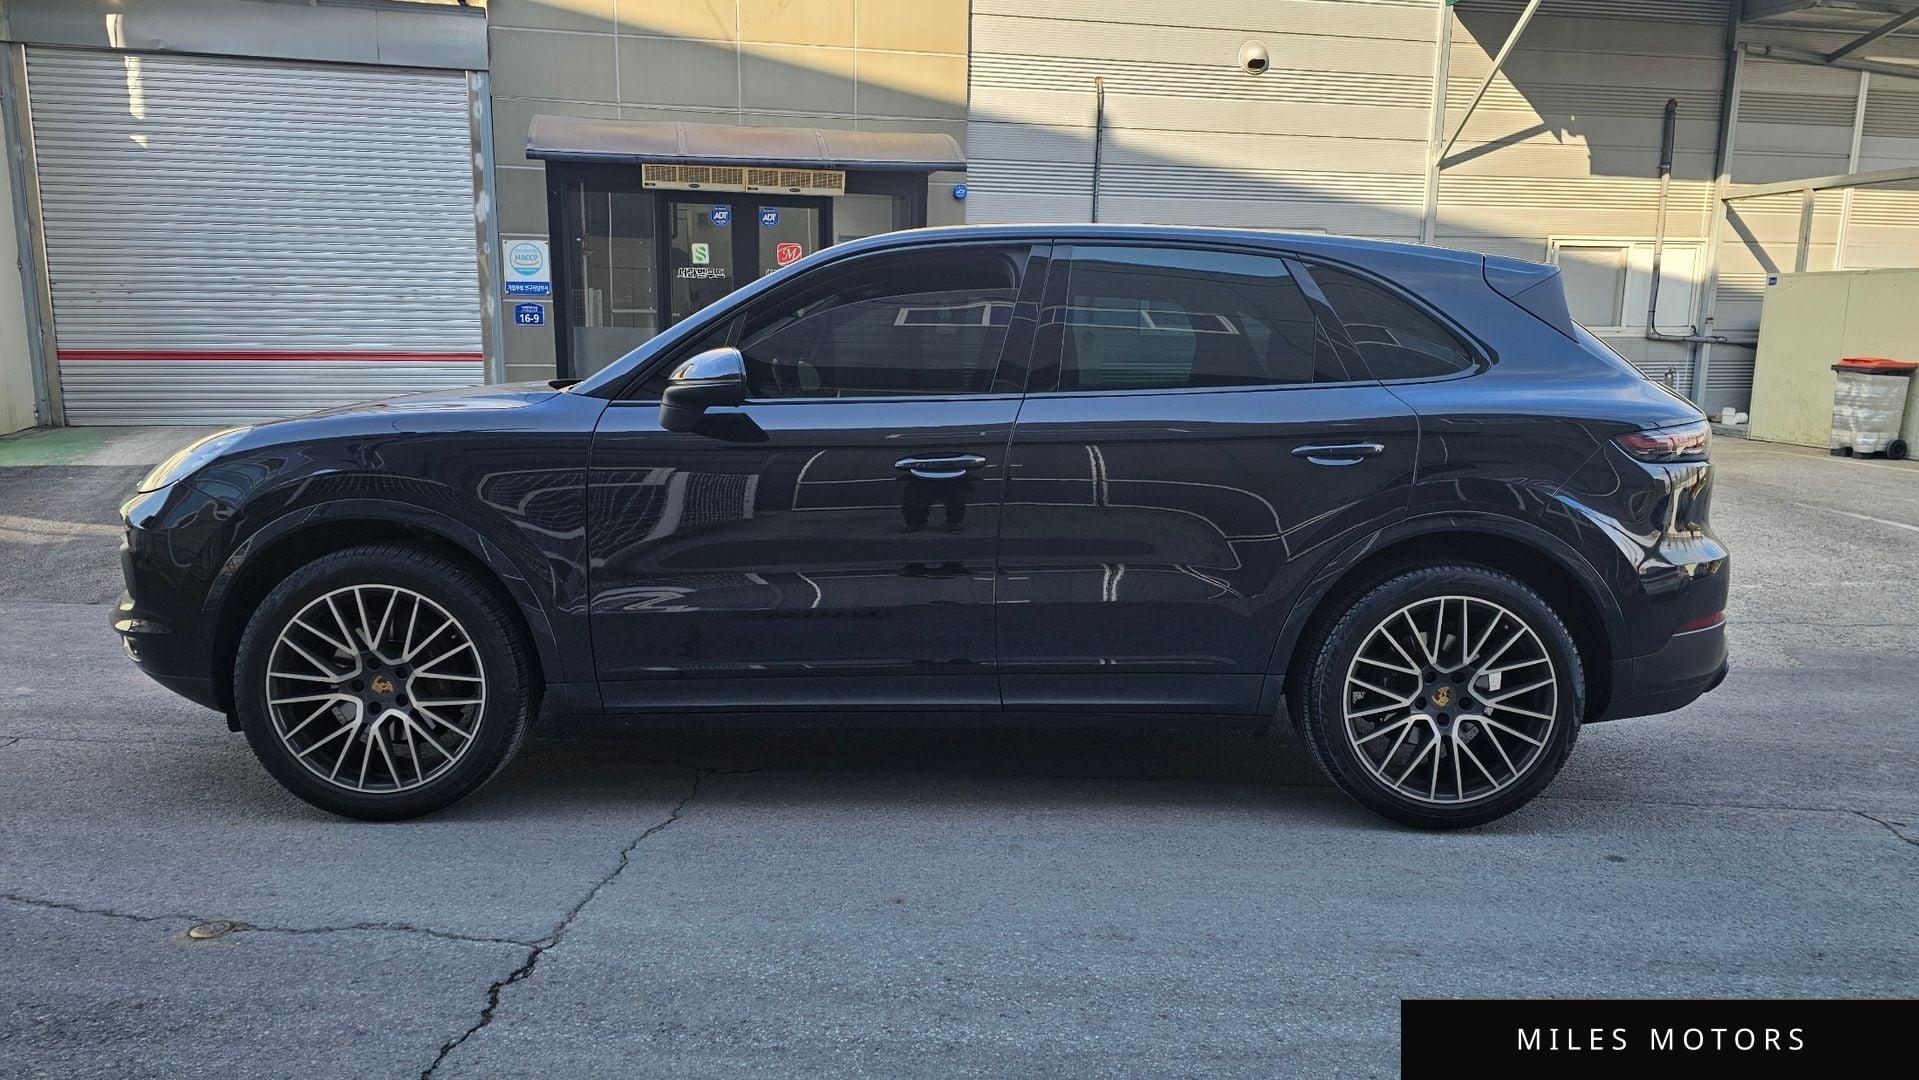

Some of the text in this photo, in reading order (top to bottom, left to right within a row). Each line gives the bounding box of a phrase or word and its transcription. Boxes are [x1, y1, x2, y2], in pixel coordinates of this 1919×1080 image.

[713, 211, 728, 220] ADT
[762, 213, 776, 222] ADT
[519, 314, 540, 323] 16-9
